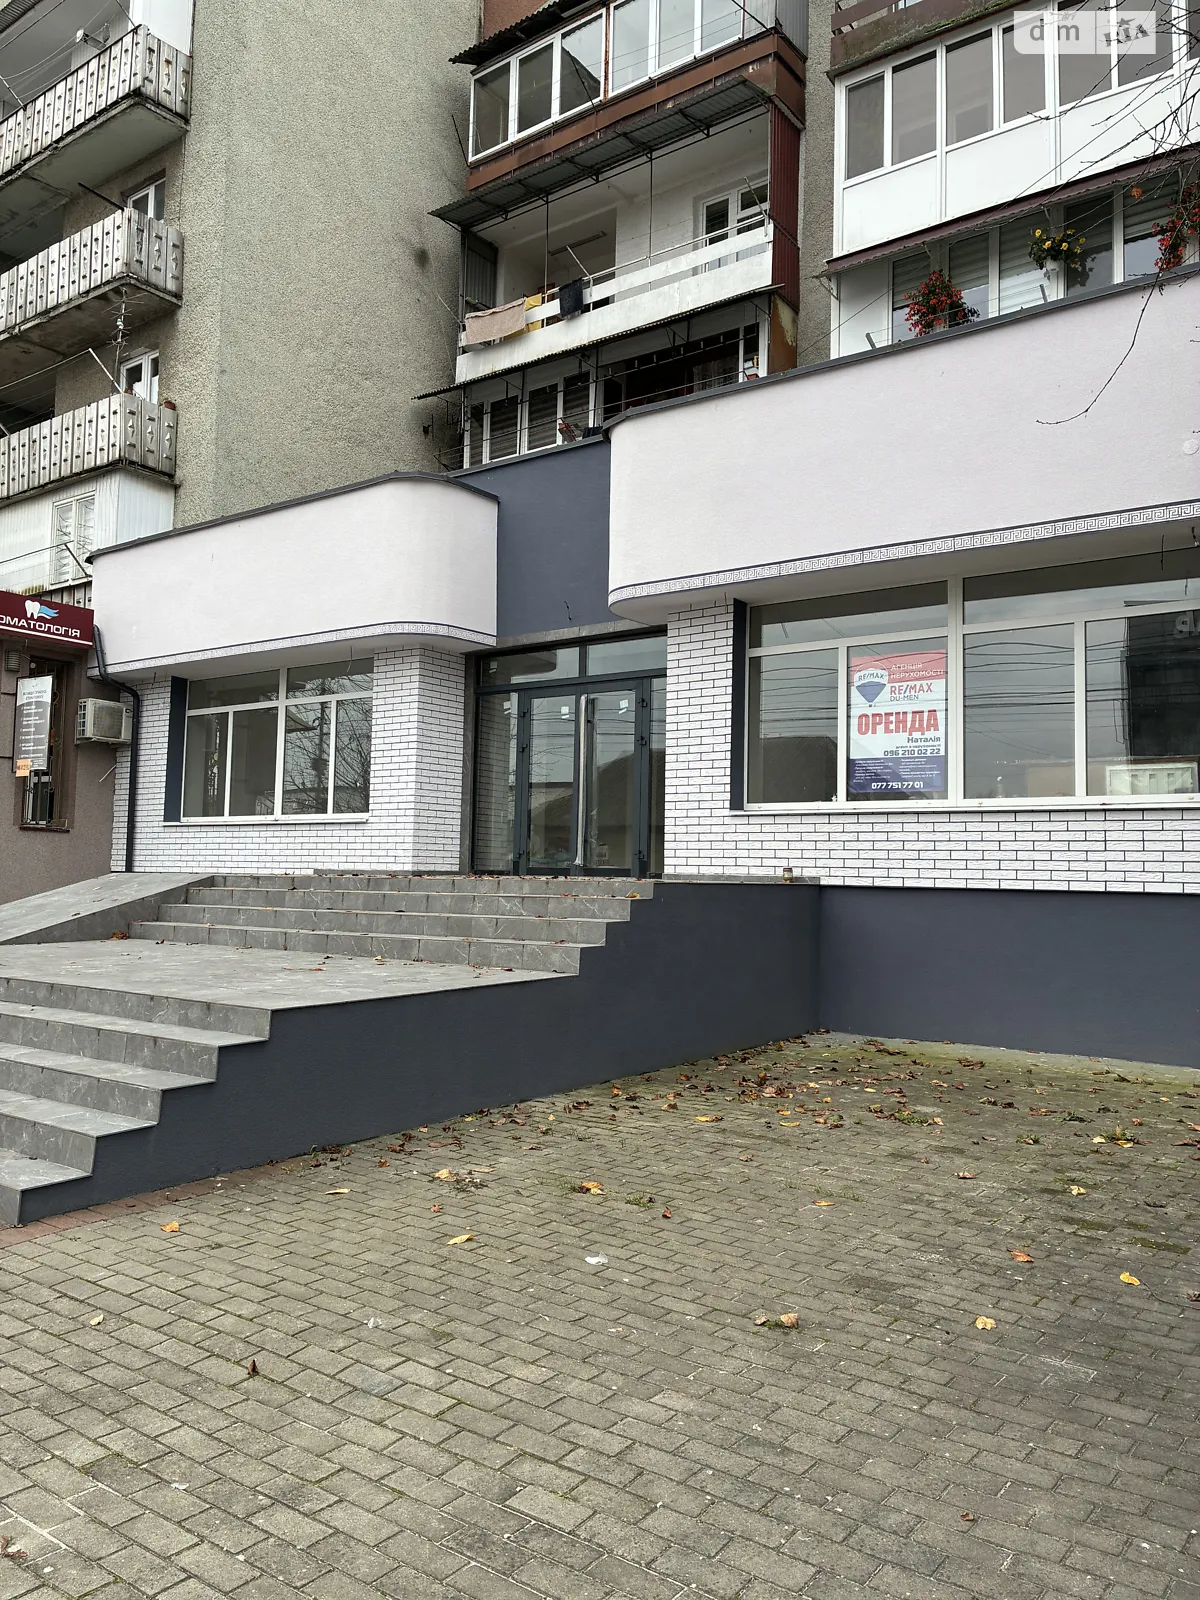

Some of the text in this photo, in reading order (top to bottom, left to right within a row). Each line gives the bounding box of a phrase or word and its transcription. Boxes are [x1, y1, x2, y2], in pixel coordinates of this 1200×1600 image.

[891, 663, 922, 671] АГЕНЦІЯ
[858, 672, 885, 682] RE/MAX
[890, 670, 943, 679] НЕРУХОМОСТІ
[890, 683, 932, 695] RE/MAX
[890, 694, 919, 702] DU-MEN
[857, 709, 940, 736] ОРЕНДА
[907, 736, 941, 744] Наталія
[871, 782, 887, 790] 077
[902, 781, 913, 789] 77
[914, 781, 924, 789] 01
